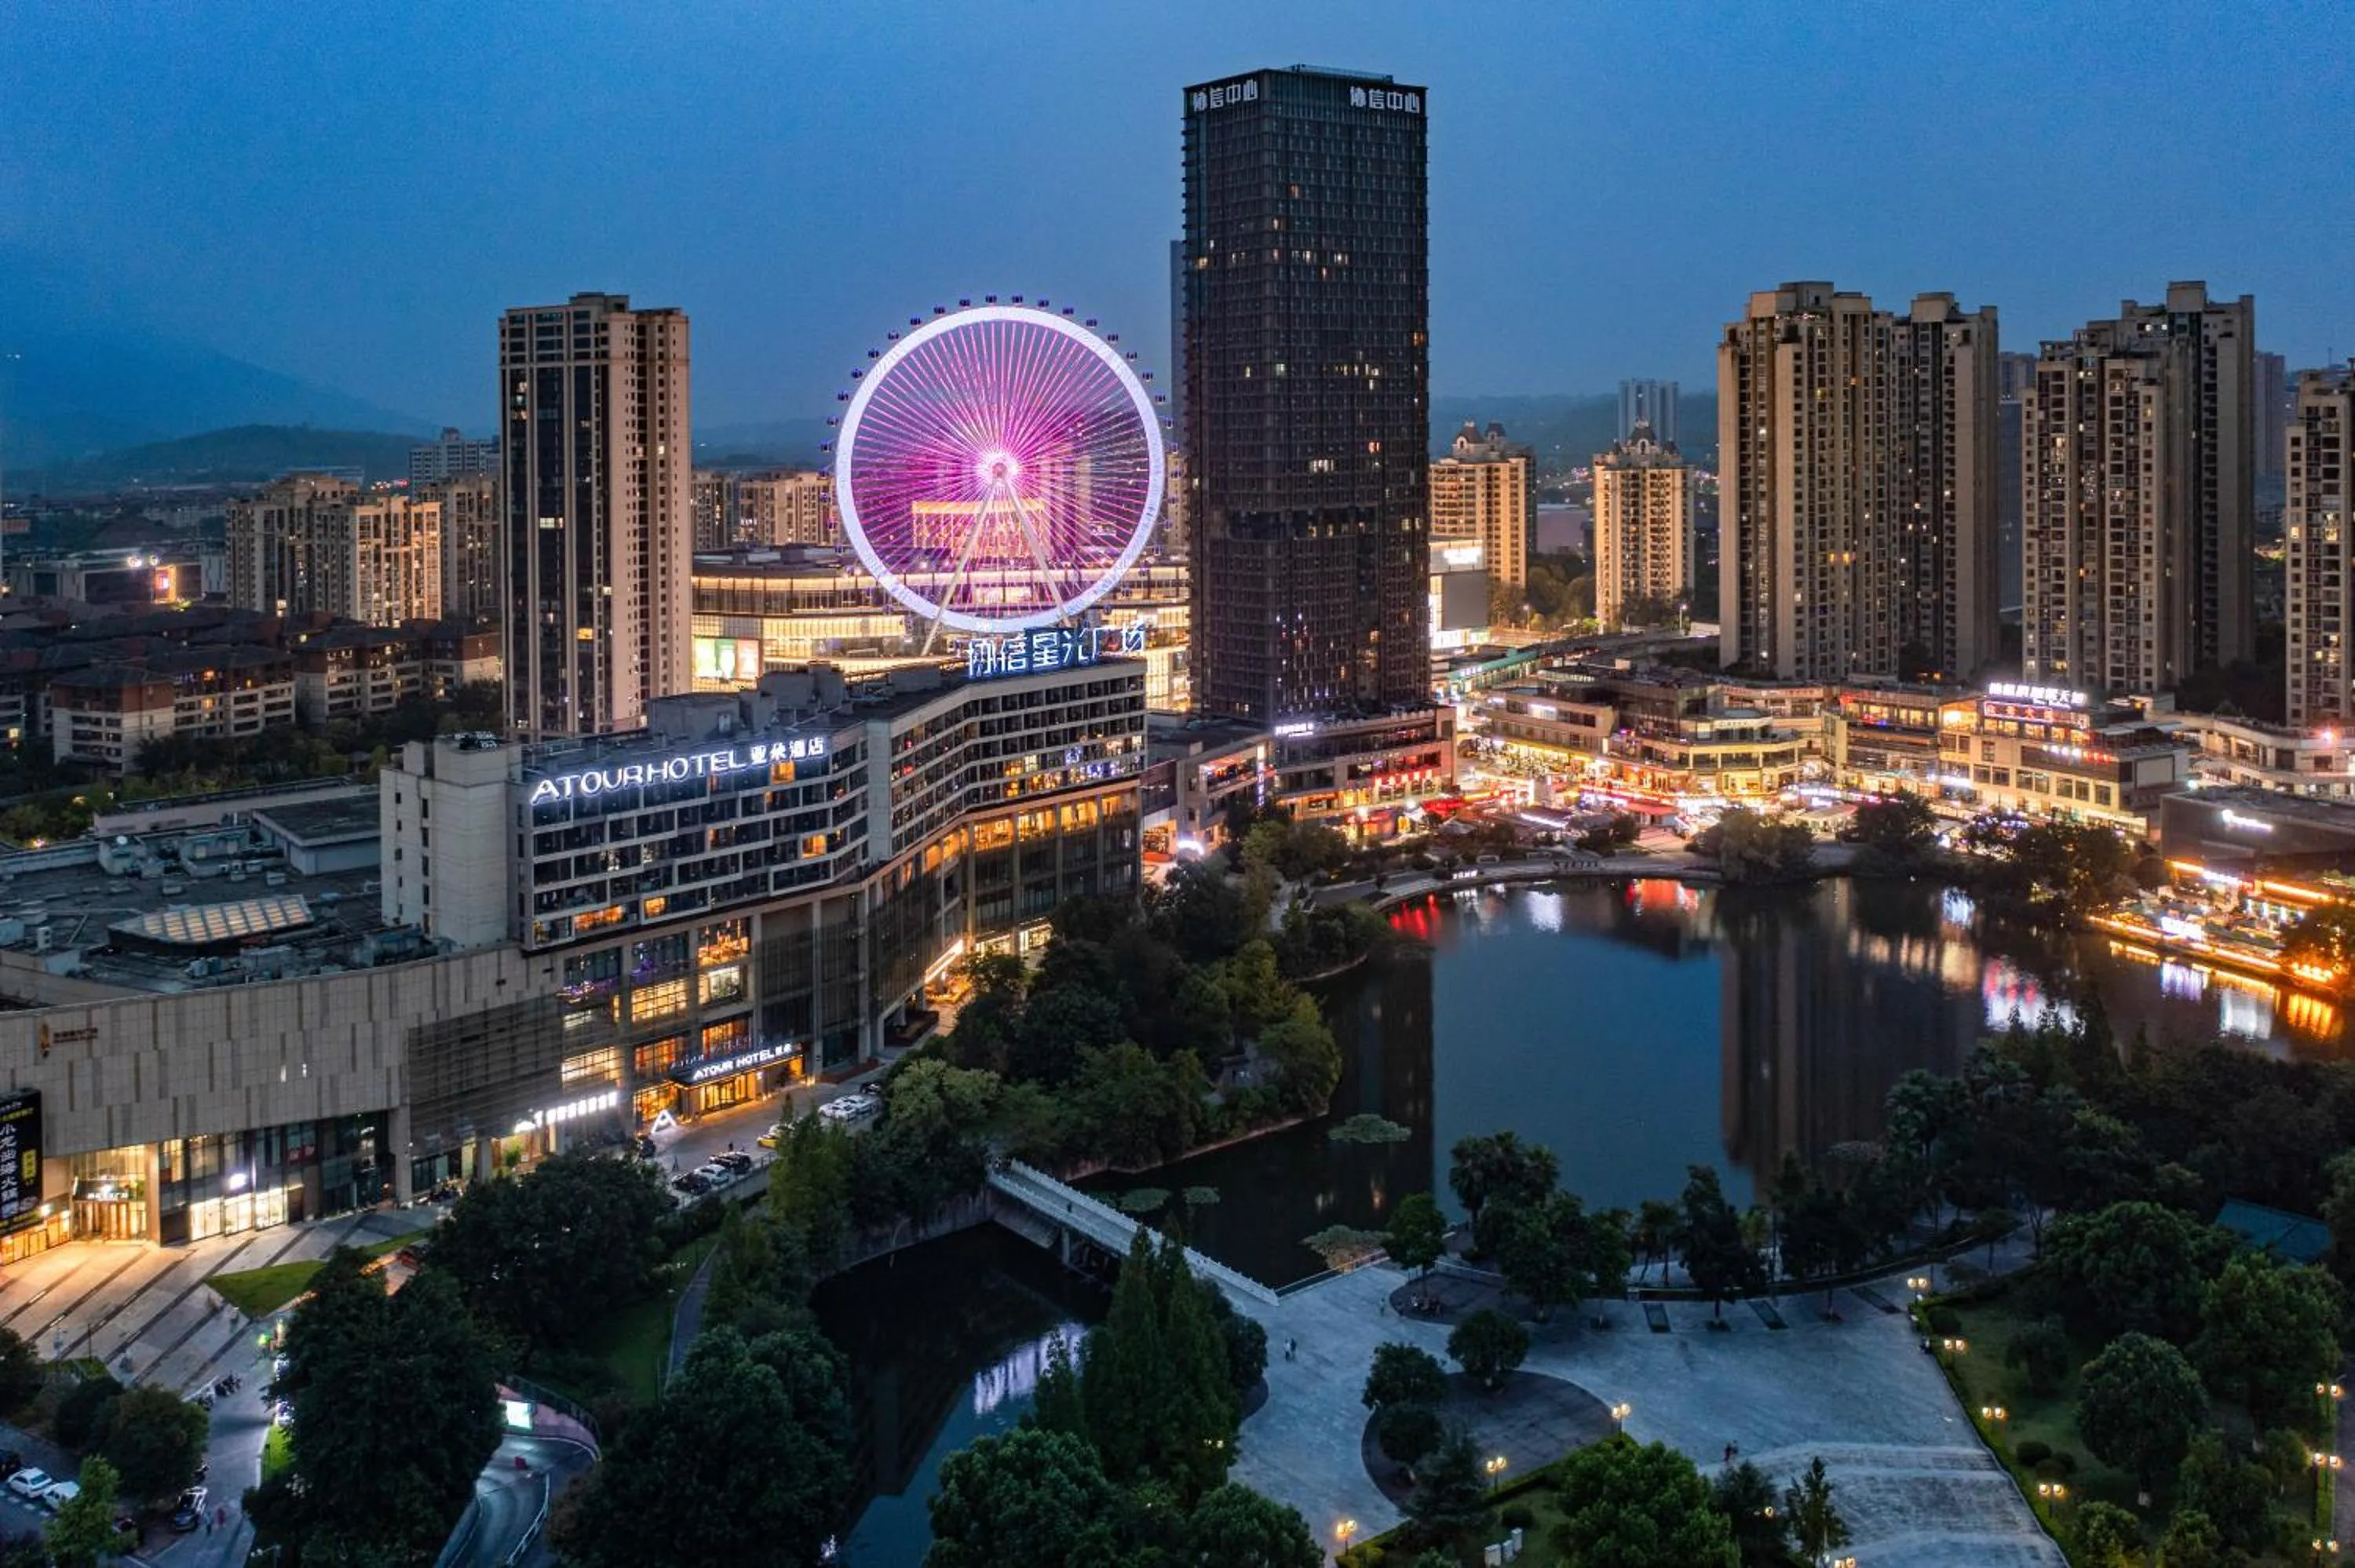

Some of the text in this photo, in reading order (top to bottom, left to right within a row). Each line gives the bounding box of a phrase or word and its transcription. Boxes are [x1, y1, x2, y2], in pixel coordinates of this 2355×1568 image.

[1192, 79, 1258, 111] 协信中心
[1349, 86, 1420, 113] 协信中心
[967, 622, 1145, 677] 协信星光广场
[647, 750, 746, 782] HOTEL
[736, 1050, 774, 1067] HOTEL
